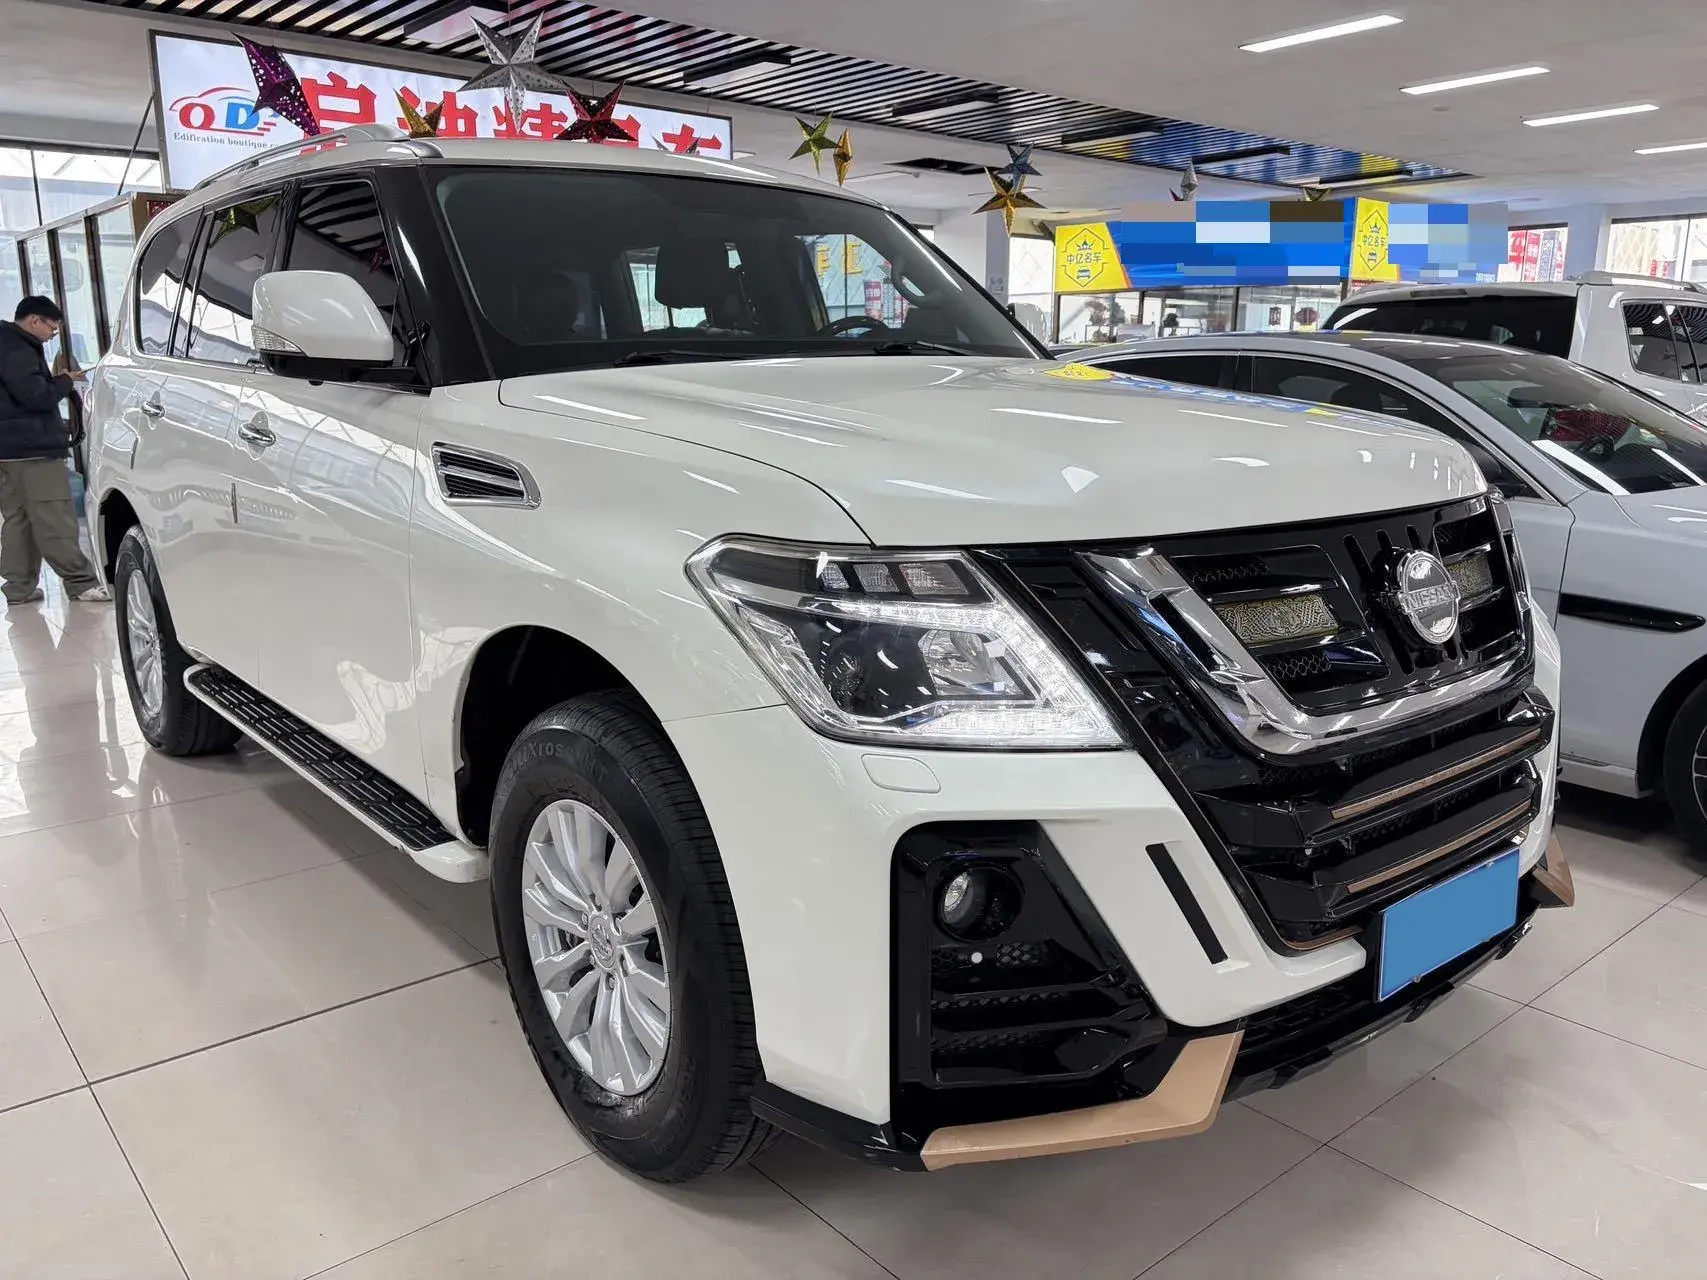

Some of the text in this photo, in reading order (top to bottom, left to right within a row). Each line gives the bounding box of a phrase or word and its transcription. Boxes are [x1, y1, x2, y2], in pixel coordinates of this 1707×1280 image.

[173, 132, 225, 145] Edification
[227, 137, 270, 150] boutique
[1066, 252, 1102, 265] 中亿名车
[1408, 585, 1456, 609] NISSAN
